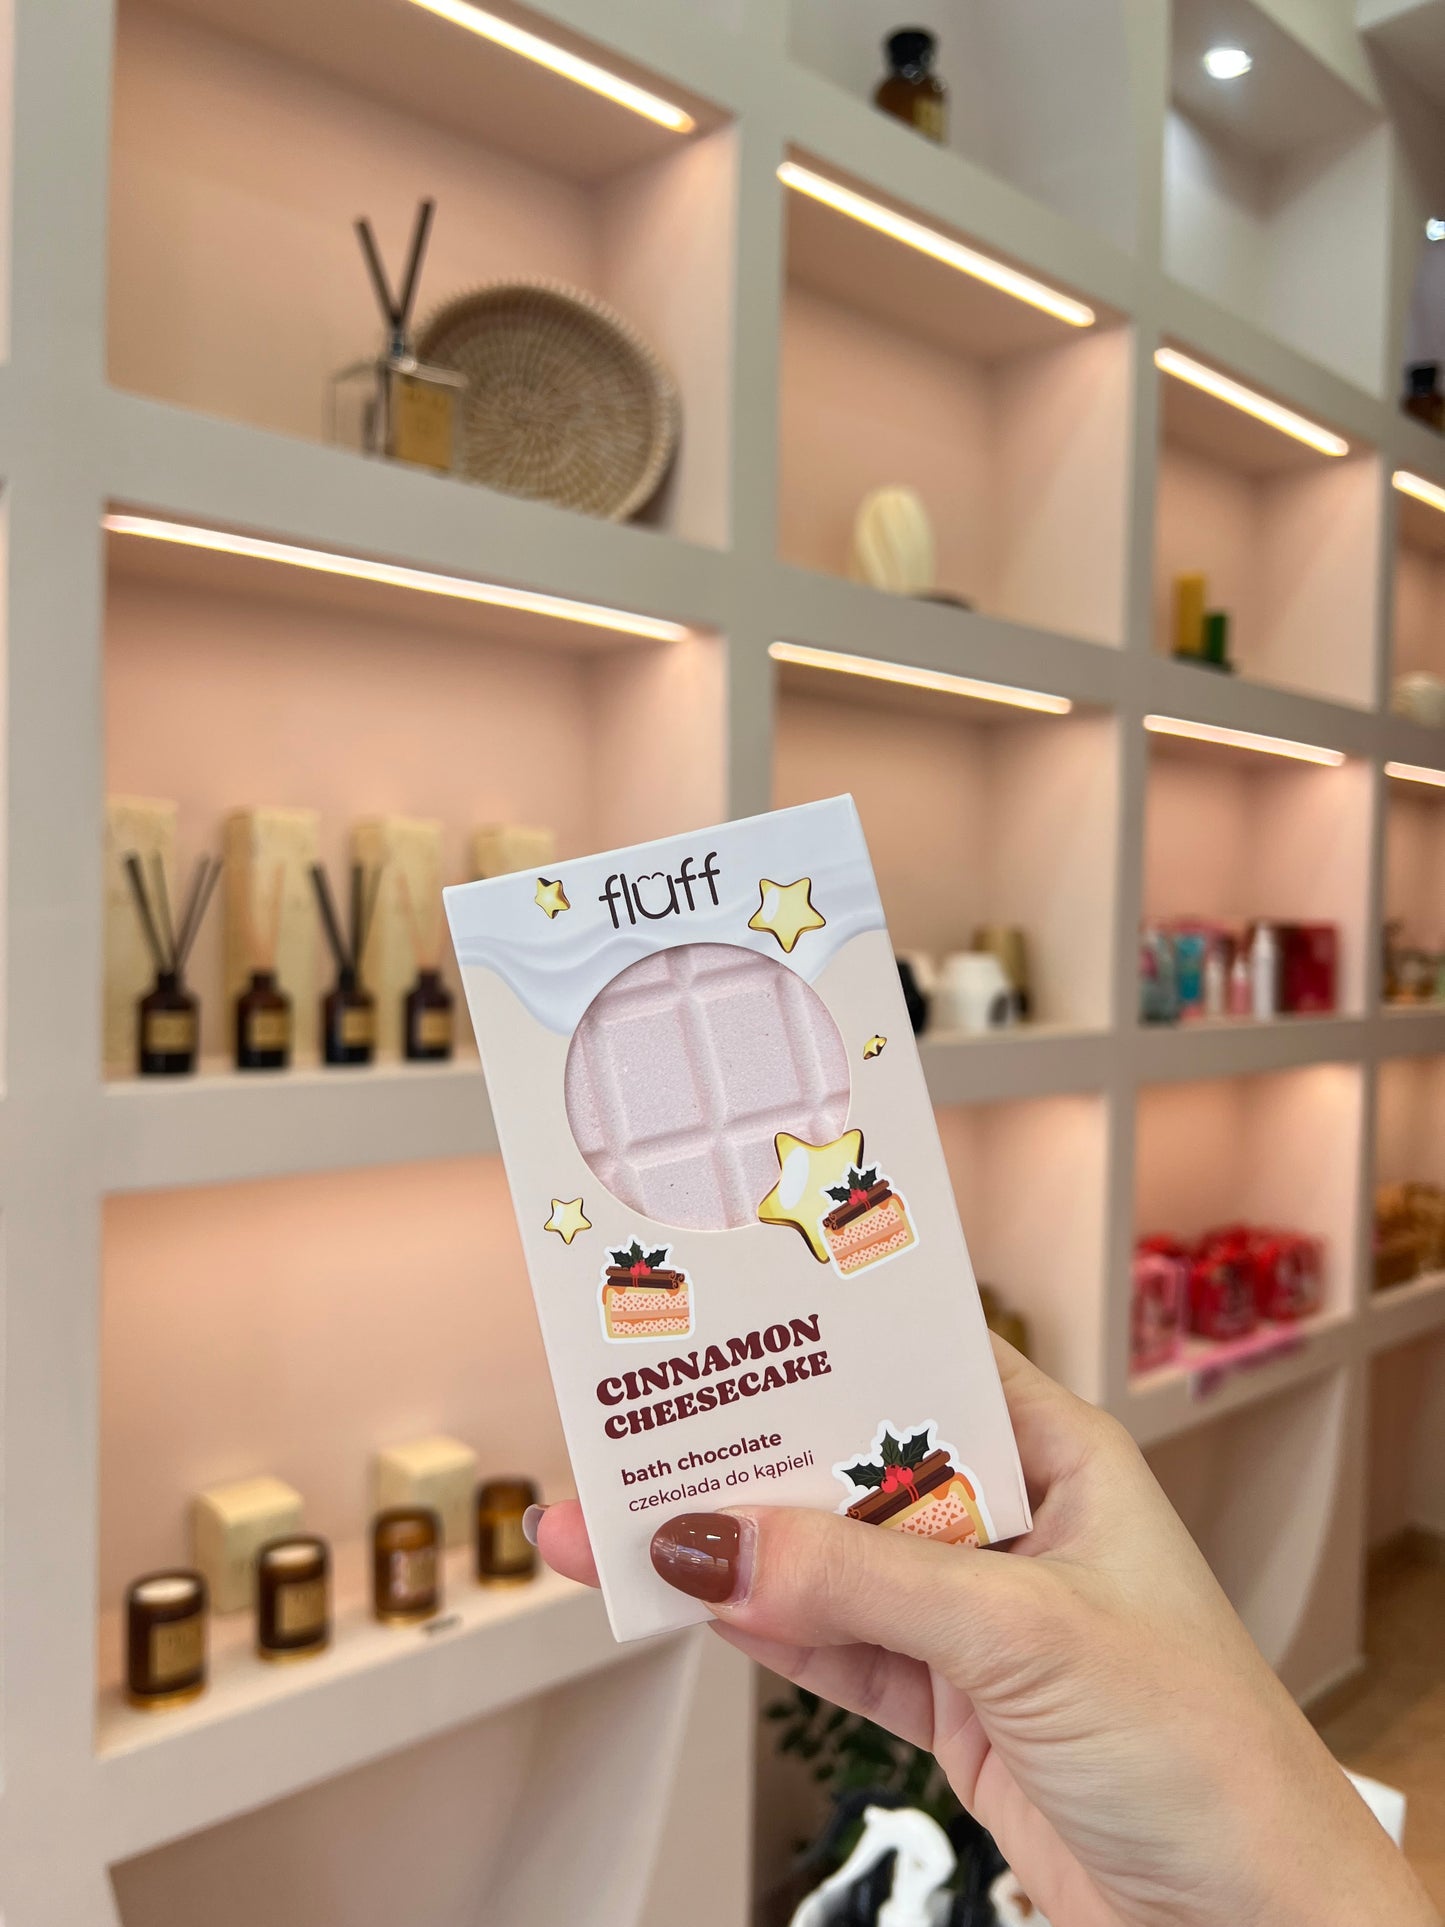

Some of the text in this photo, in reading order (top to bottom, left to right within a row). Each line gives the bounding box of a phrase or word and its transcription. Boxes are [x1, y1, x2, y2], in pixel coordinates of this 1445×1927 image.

[596, 1313, 821, 1406] CINNAMON
[604, 1350, 832, 1440] CHEESECAKE
[621, 1432, 783, 1486] bath chocolate
[628, 1450, 815, 1512] czekolada do kąpieli
